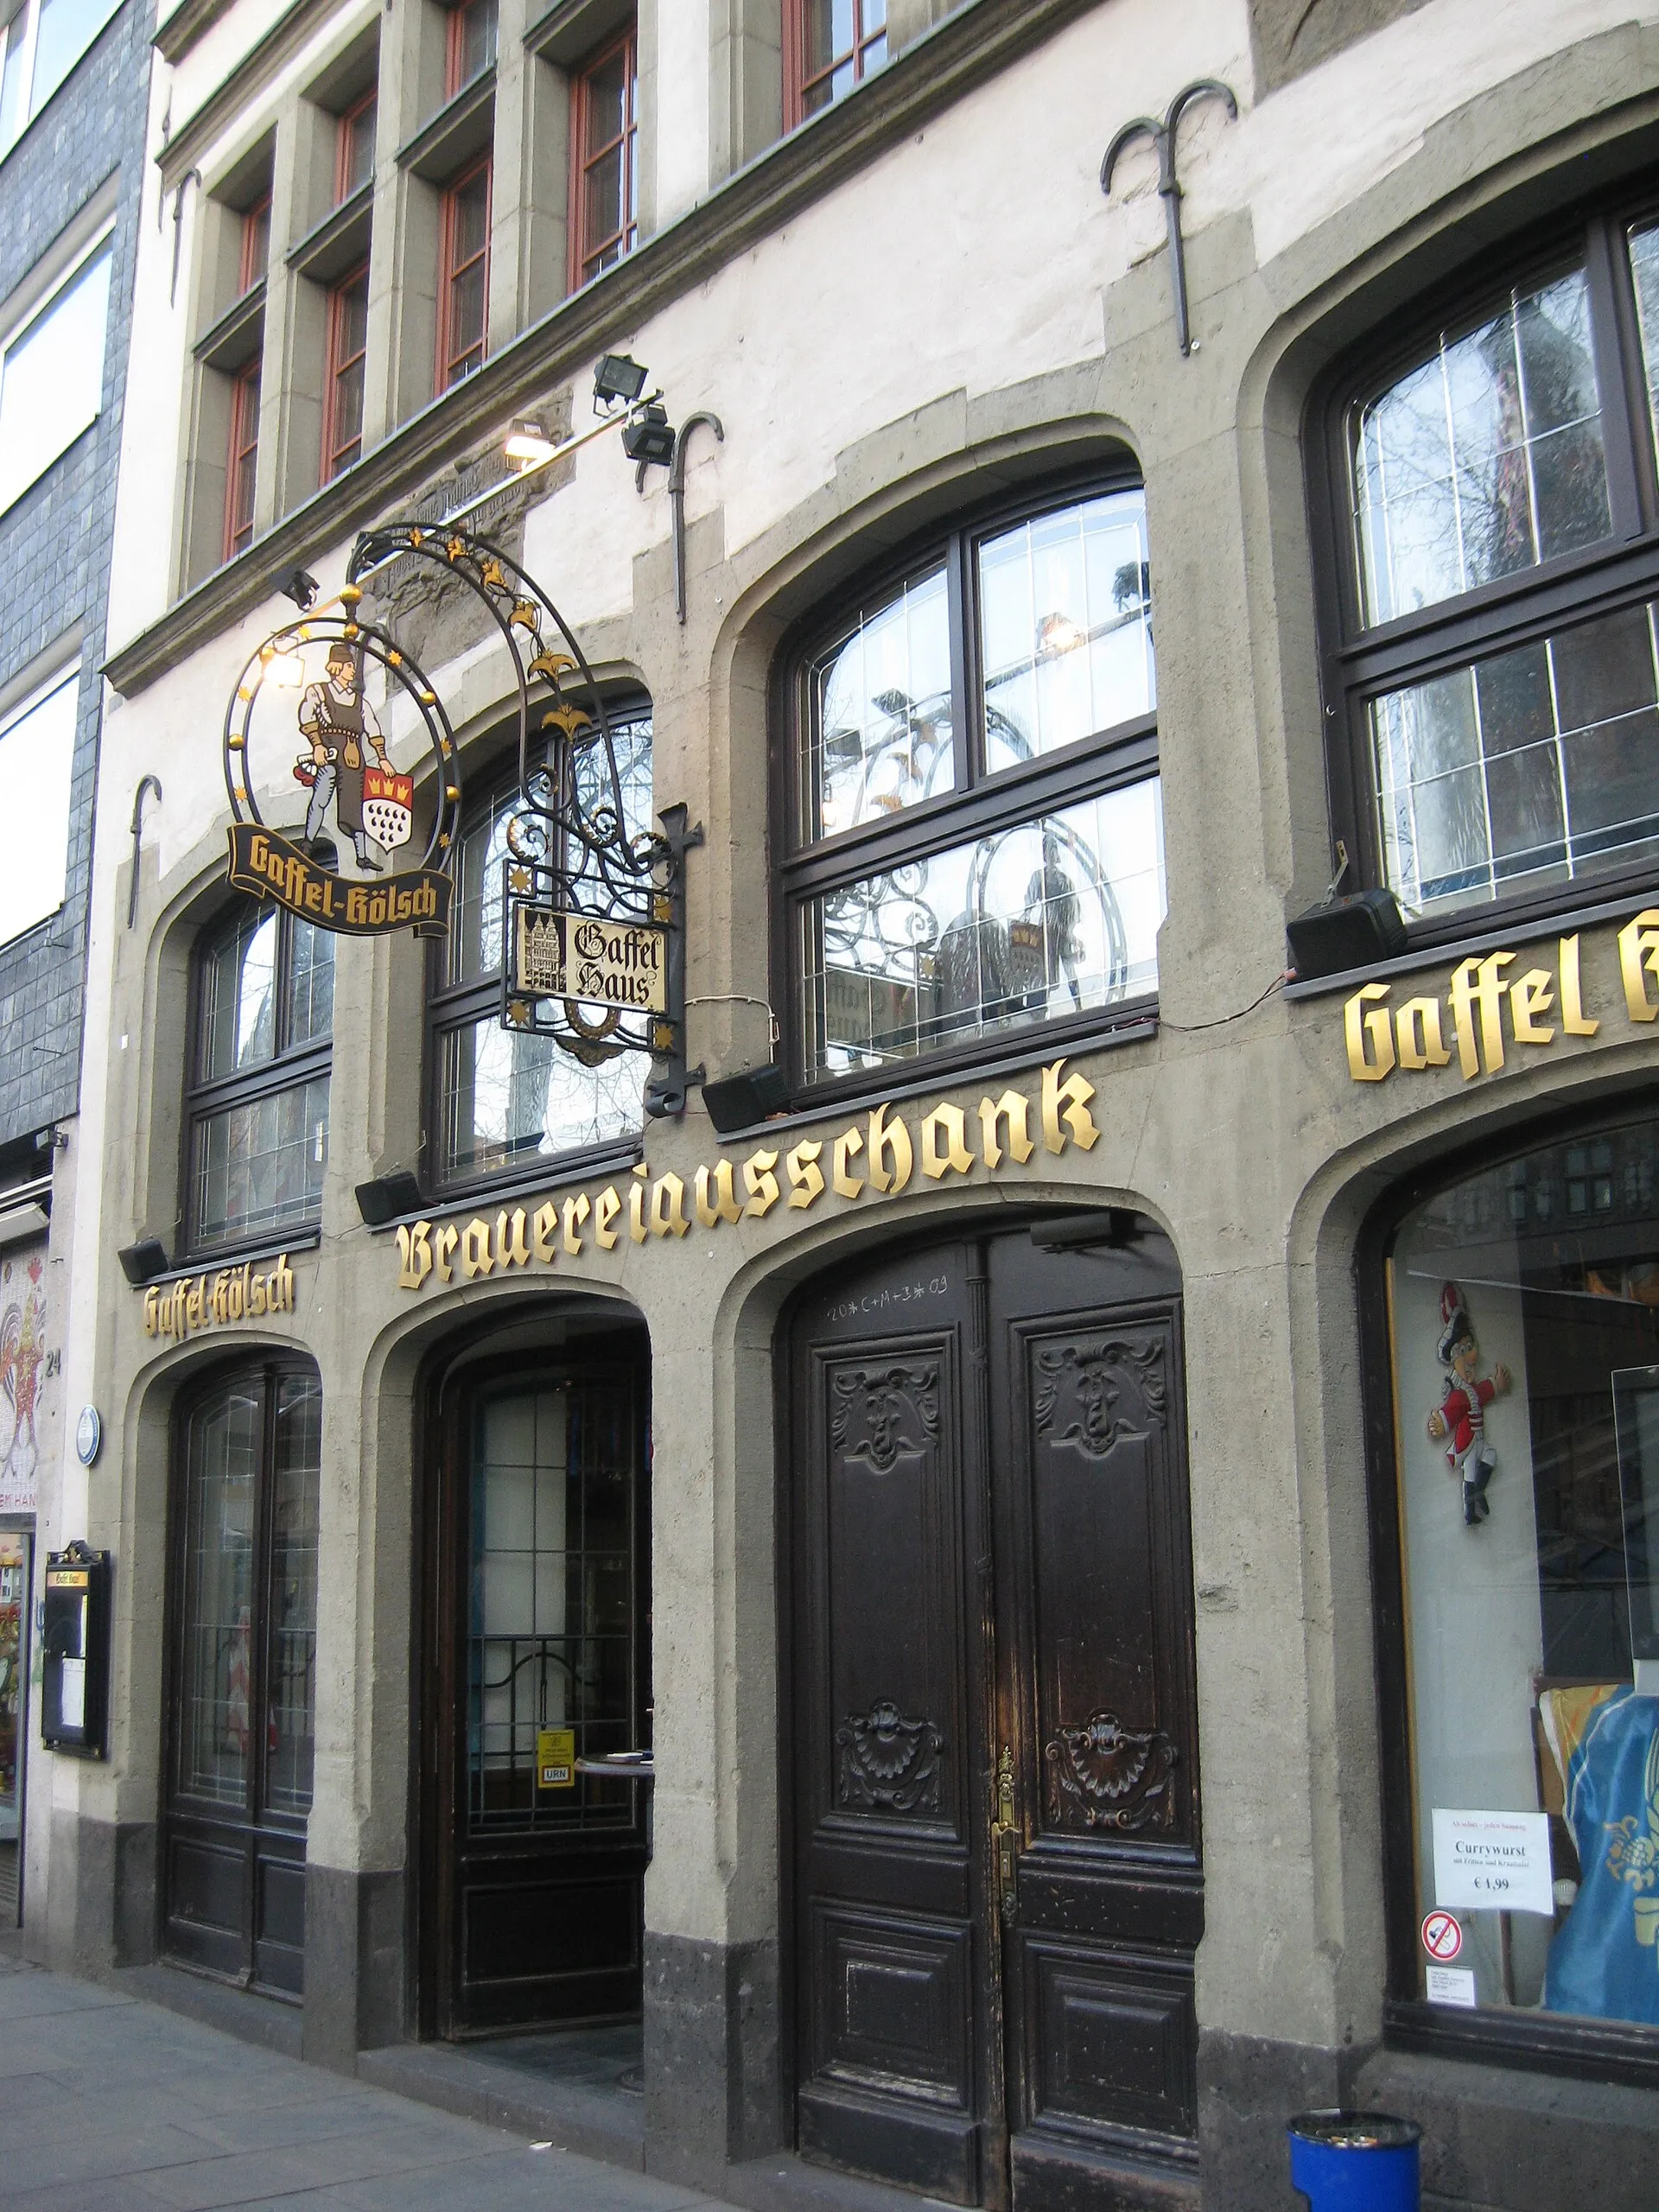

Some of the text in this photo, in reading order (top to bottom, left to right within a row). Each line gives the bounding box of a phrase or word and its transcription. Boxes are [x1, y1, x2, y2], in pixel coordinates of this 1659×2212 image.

[249, 834, 436, 925] Gaffel-Kölsch
[575, 921, 661, 971] Gaffel
[575, 961, 655, 1004] Haus
[1344, 933, 1599, 1080] Gaffel
[394, 1057, 1100, 1289] Brauereiausschank
[46, 1348, 60, 1377] 24
[1455, 1840, 1526, 1857] Currywurst
[1474, 1876, 1481, 1889] €
